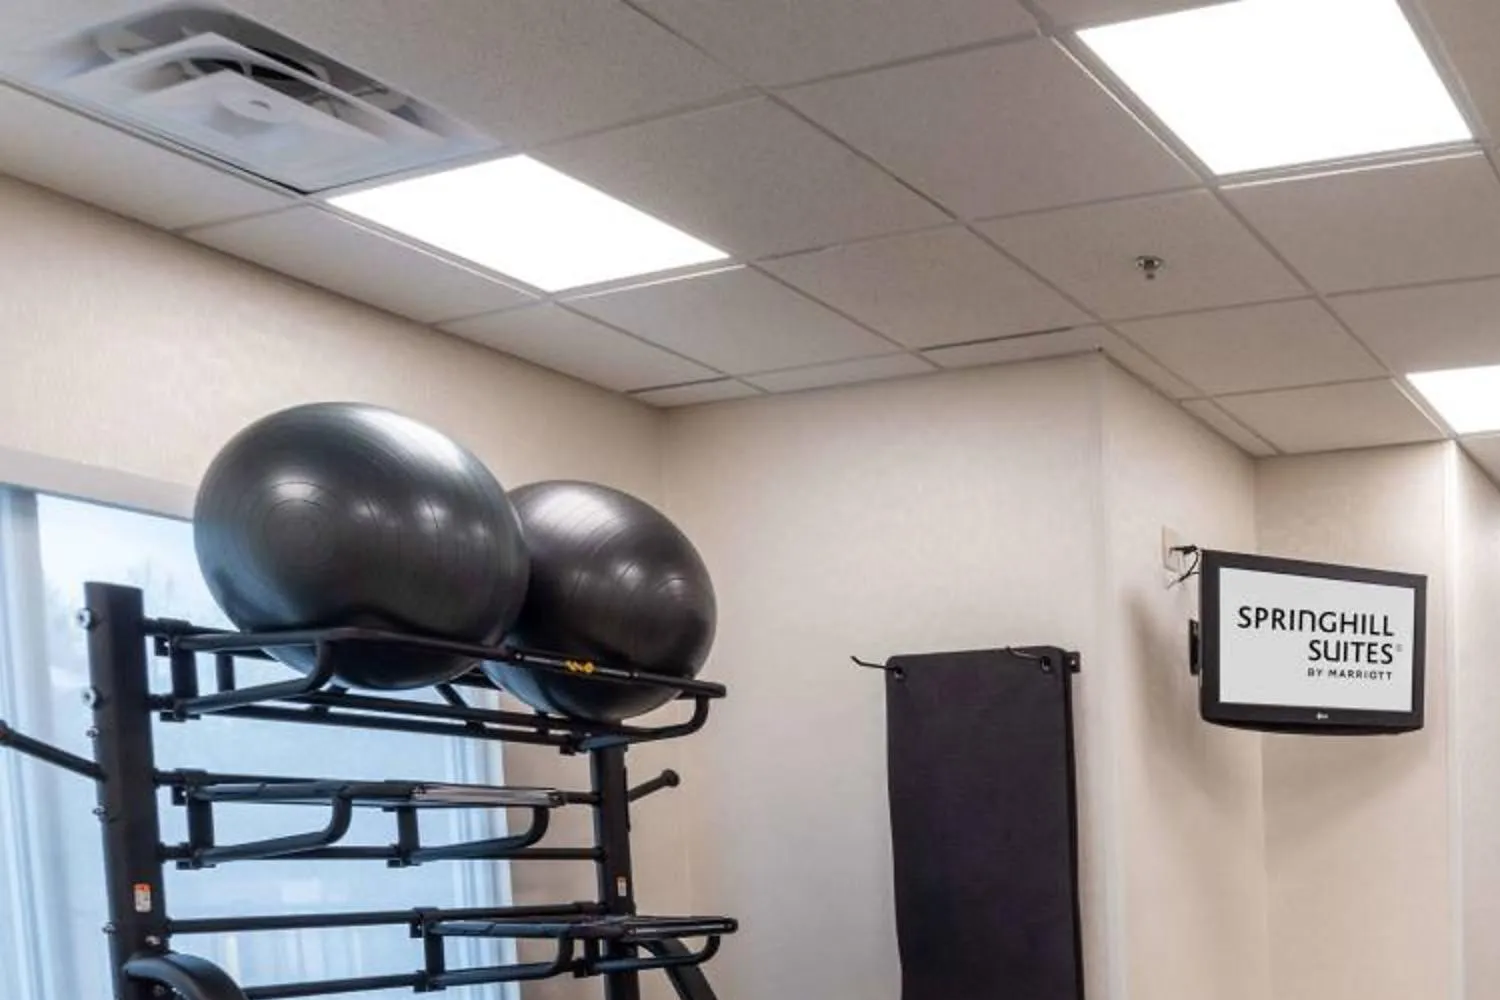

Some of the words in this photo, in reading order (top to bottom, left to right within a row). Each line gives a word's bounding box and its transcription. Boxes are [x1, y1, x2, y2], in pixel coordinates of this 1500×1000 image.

[1237, 605, 1395, 637] SPRINGHILL
[1308, 639, 1393, 664] SUITES
[1307, 668, 1322, 678] BY
[1328, 669, 1393, 681] MARRIOTT
